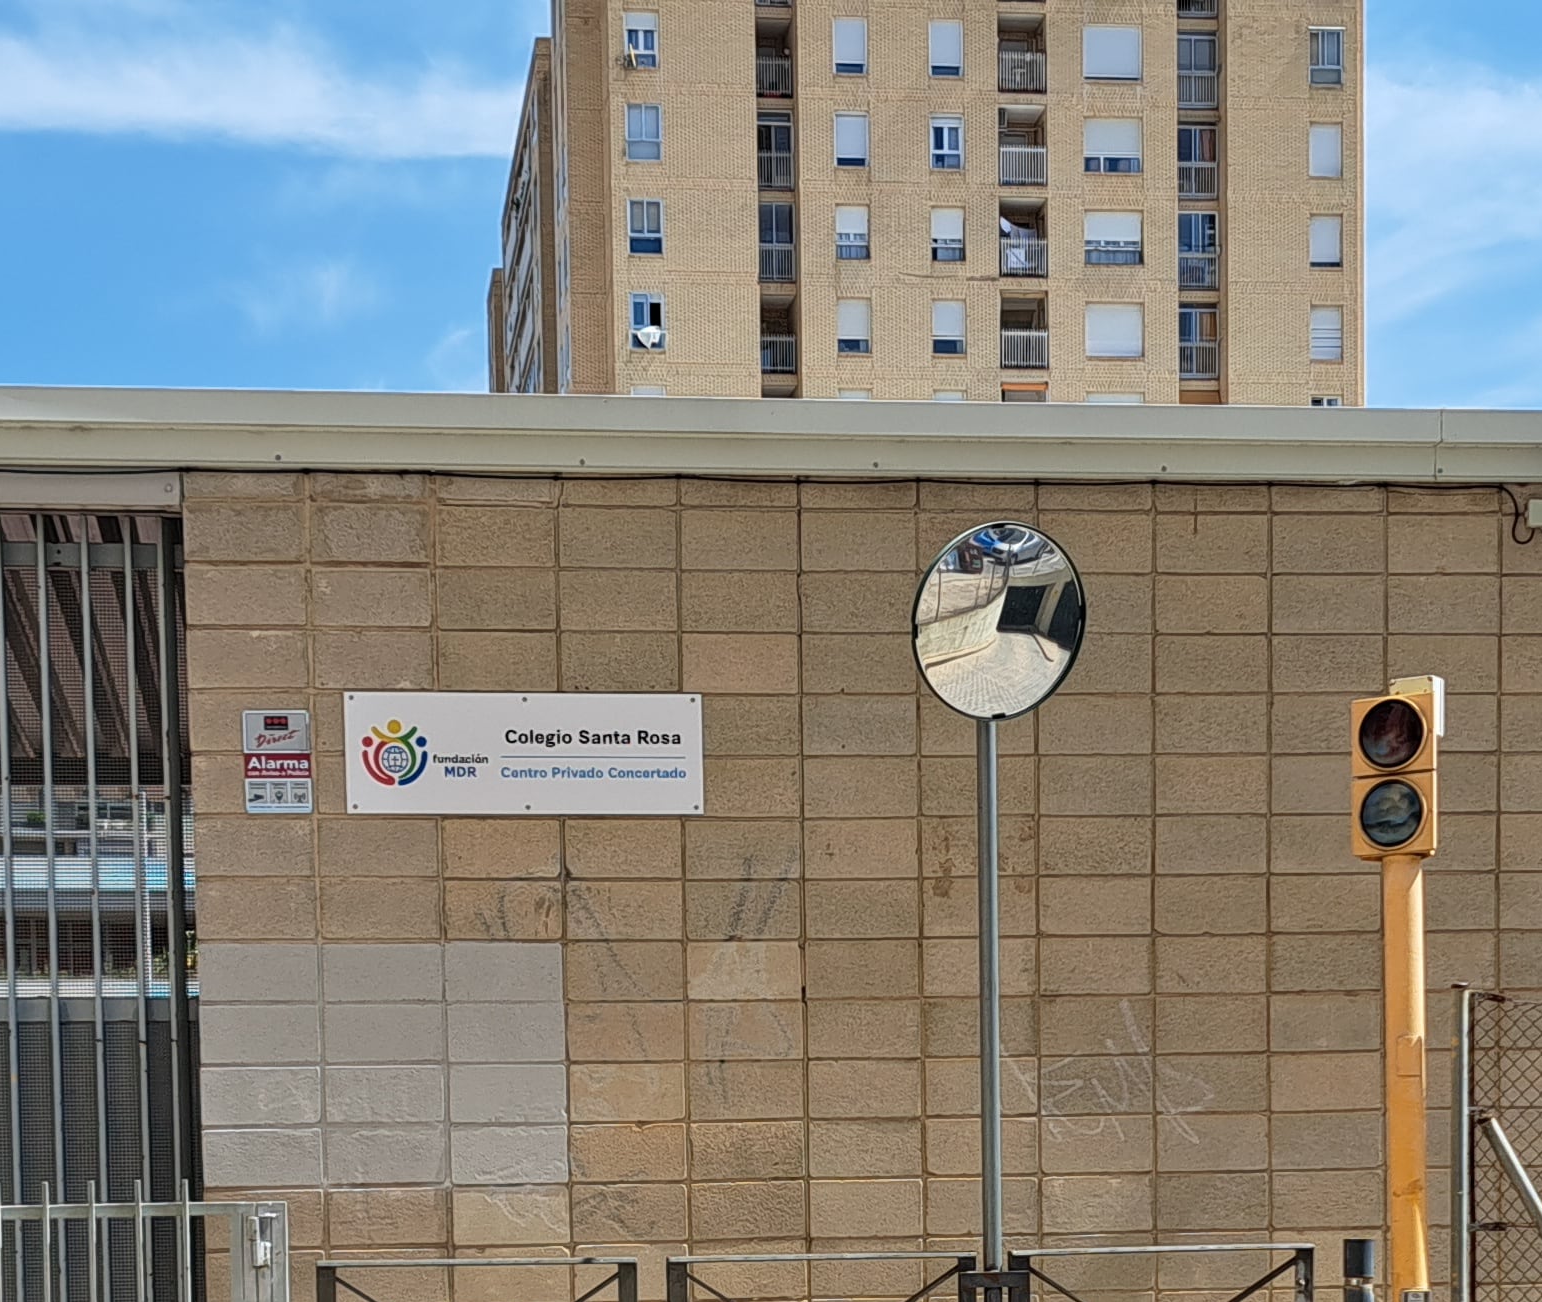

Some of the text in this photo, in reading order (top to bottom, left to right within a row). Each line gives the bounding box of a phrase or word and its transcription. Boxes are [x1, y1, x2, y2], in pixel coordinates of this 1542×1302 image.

[504, 730, 682, 747] Colegio Santa Rosa
[248, 756, 309, 769] Alarma
[432, 753, 489, 765] fundación
[444, 767, 477, 778] MDR
[500, 767, 687, 779] Centro Privado Concertado
